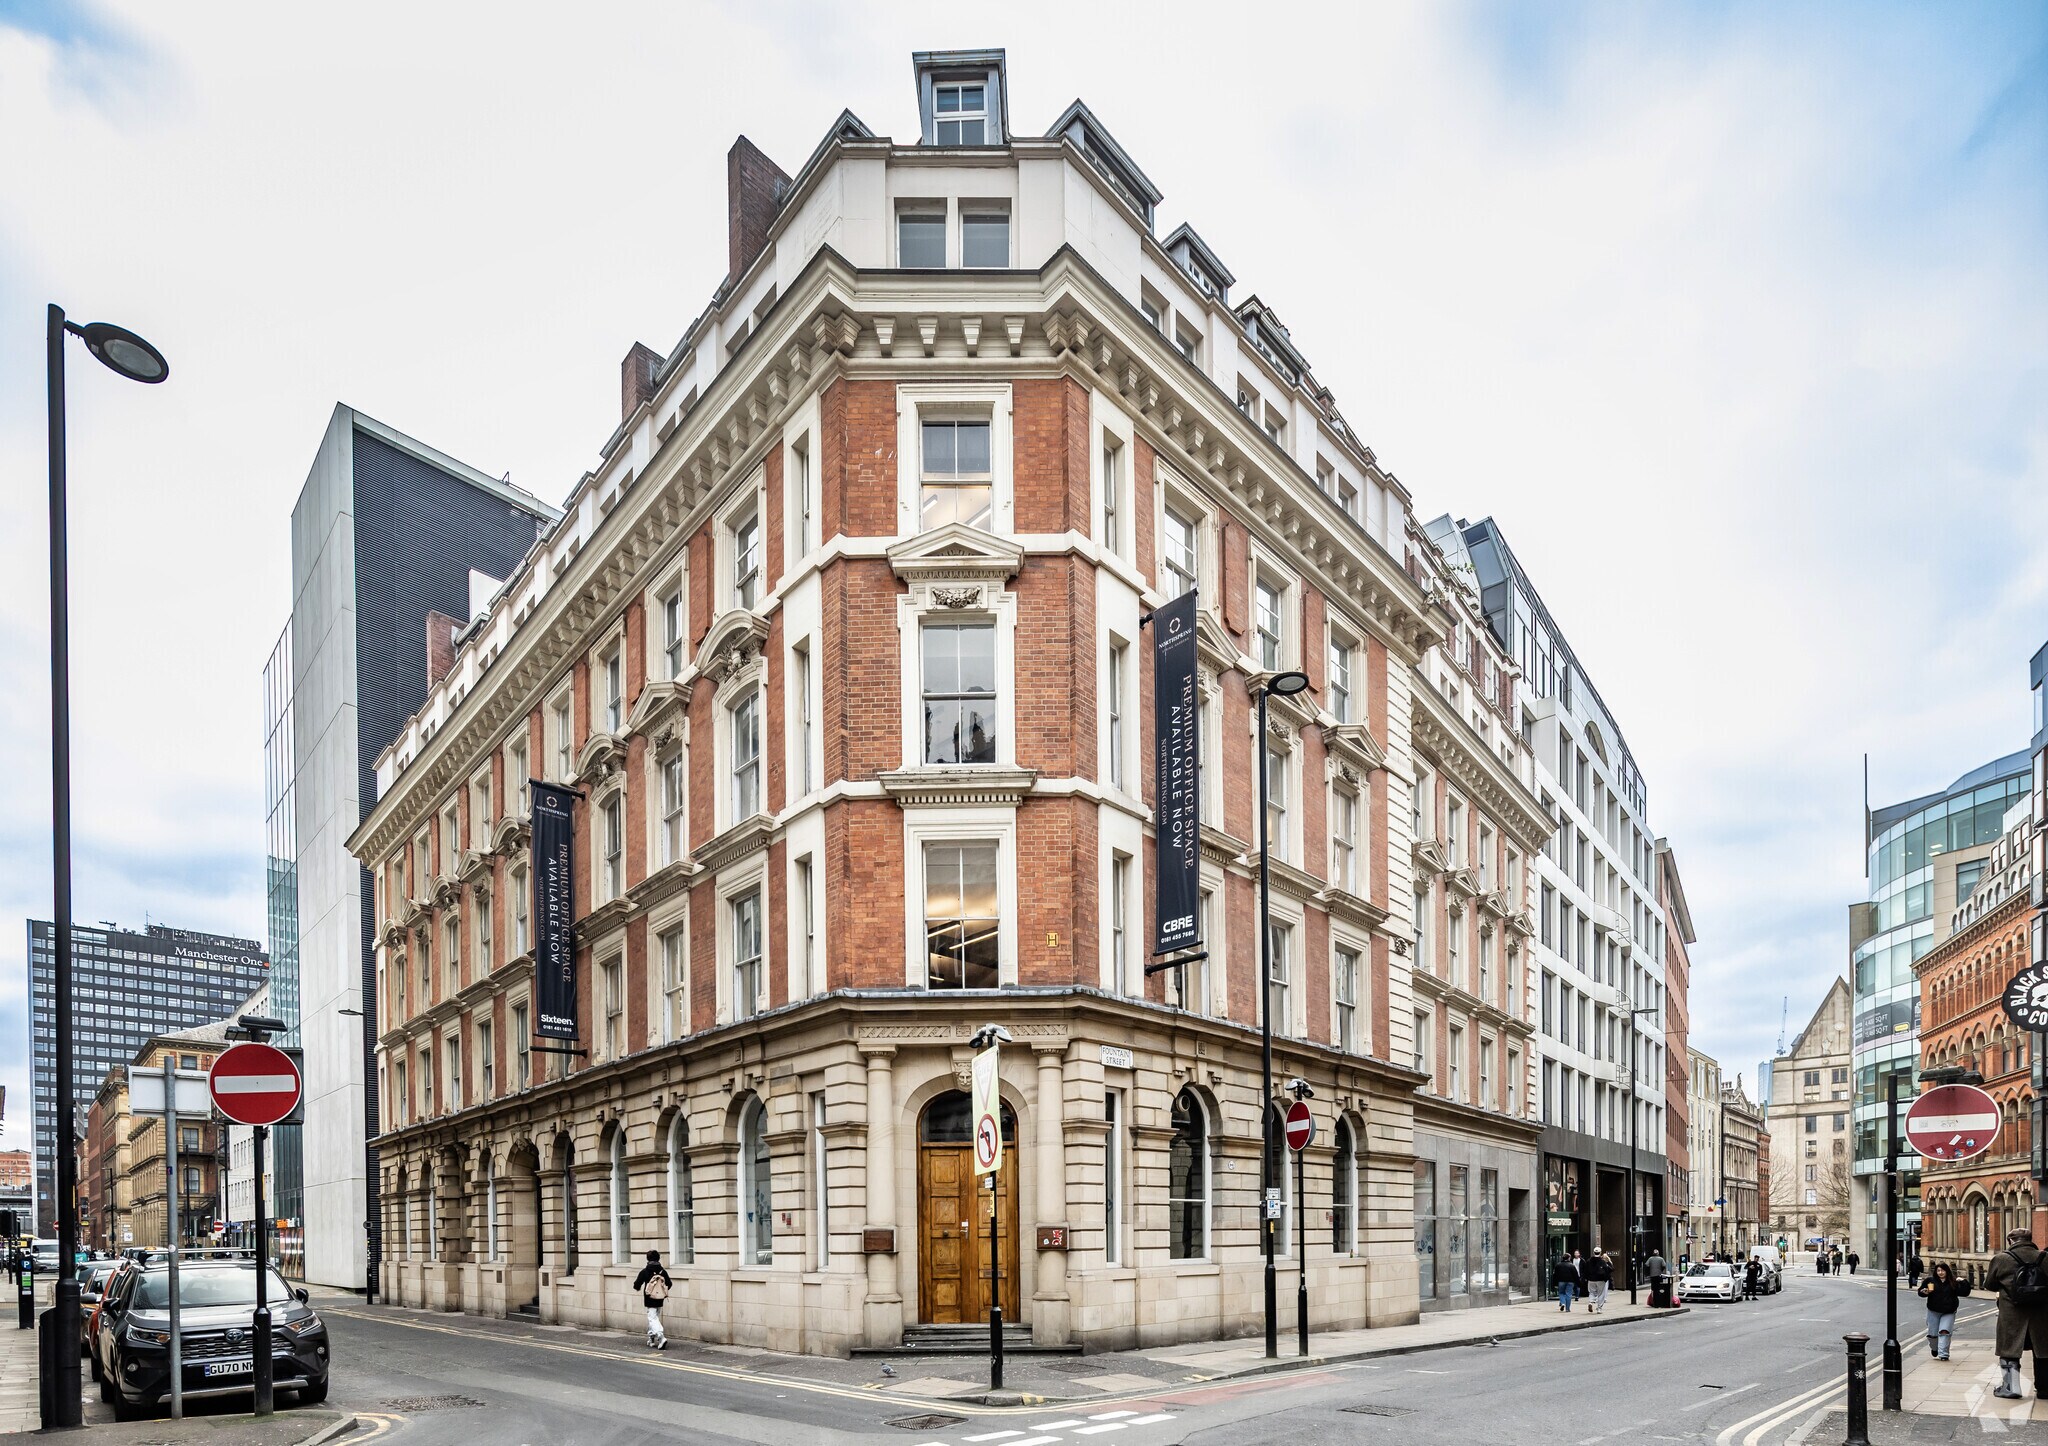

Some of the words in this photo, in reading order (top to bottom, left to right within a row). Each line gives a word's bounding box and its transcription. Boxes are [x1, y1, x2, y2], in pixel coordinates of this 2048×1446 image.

[1158, 627, 1193, 649] NORTHSPRING
[1183, 674, 1193, 752] PREMIUM
[1171, 706, 1182, 799] AVAILABLE
[1184, 756, 1194, 816] OFFICE
[1172, 808, 1182, 848] NOW
[1184, 819, 1194, 869] SPACE
[559, 843, 569, 898] PREMIUM
[548, 857, 559, 927] AVAILABLE
[561, 901, 571, 944] OFFICE
[1163, 914, 1194, 933] CBRE
[174, 946, 239, 963] Manchester
[240, 955, 263, 967] One
[550, 933, 559, 964] NOW
[562, 946, 571, 982] SPACE
[2010, 969, 2042, 1007] BLACK
[2042, 965, 2048, 980] S
[541, 1014, 574, 1026] Sixteen.
[2028, 1010, 2048, 1026] CO
[1103, 1047, 1130, 1058] FOUNTAIN
[1106, 1056, 1126, 1066] STREET
[210, 1363, 239, 1375] GU70
